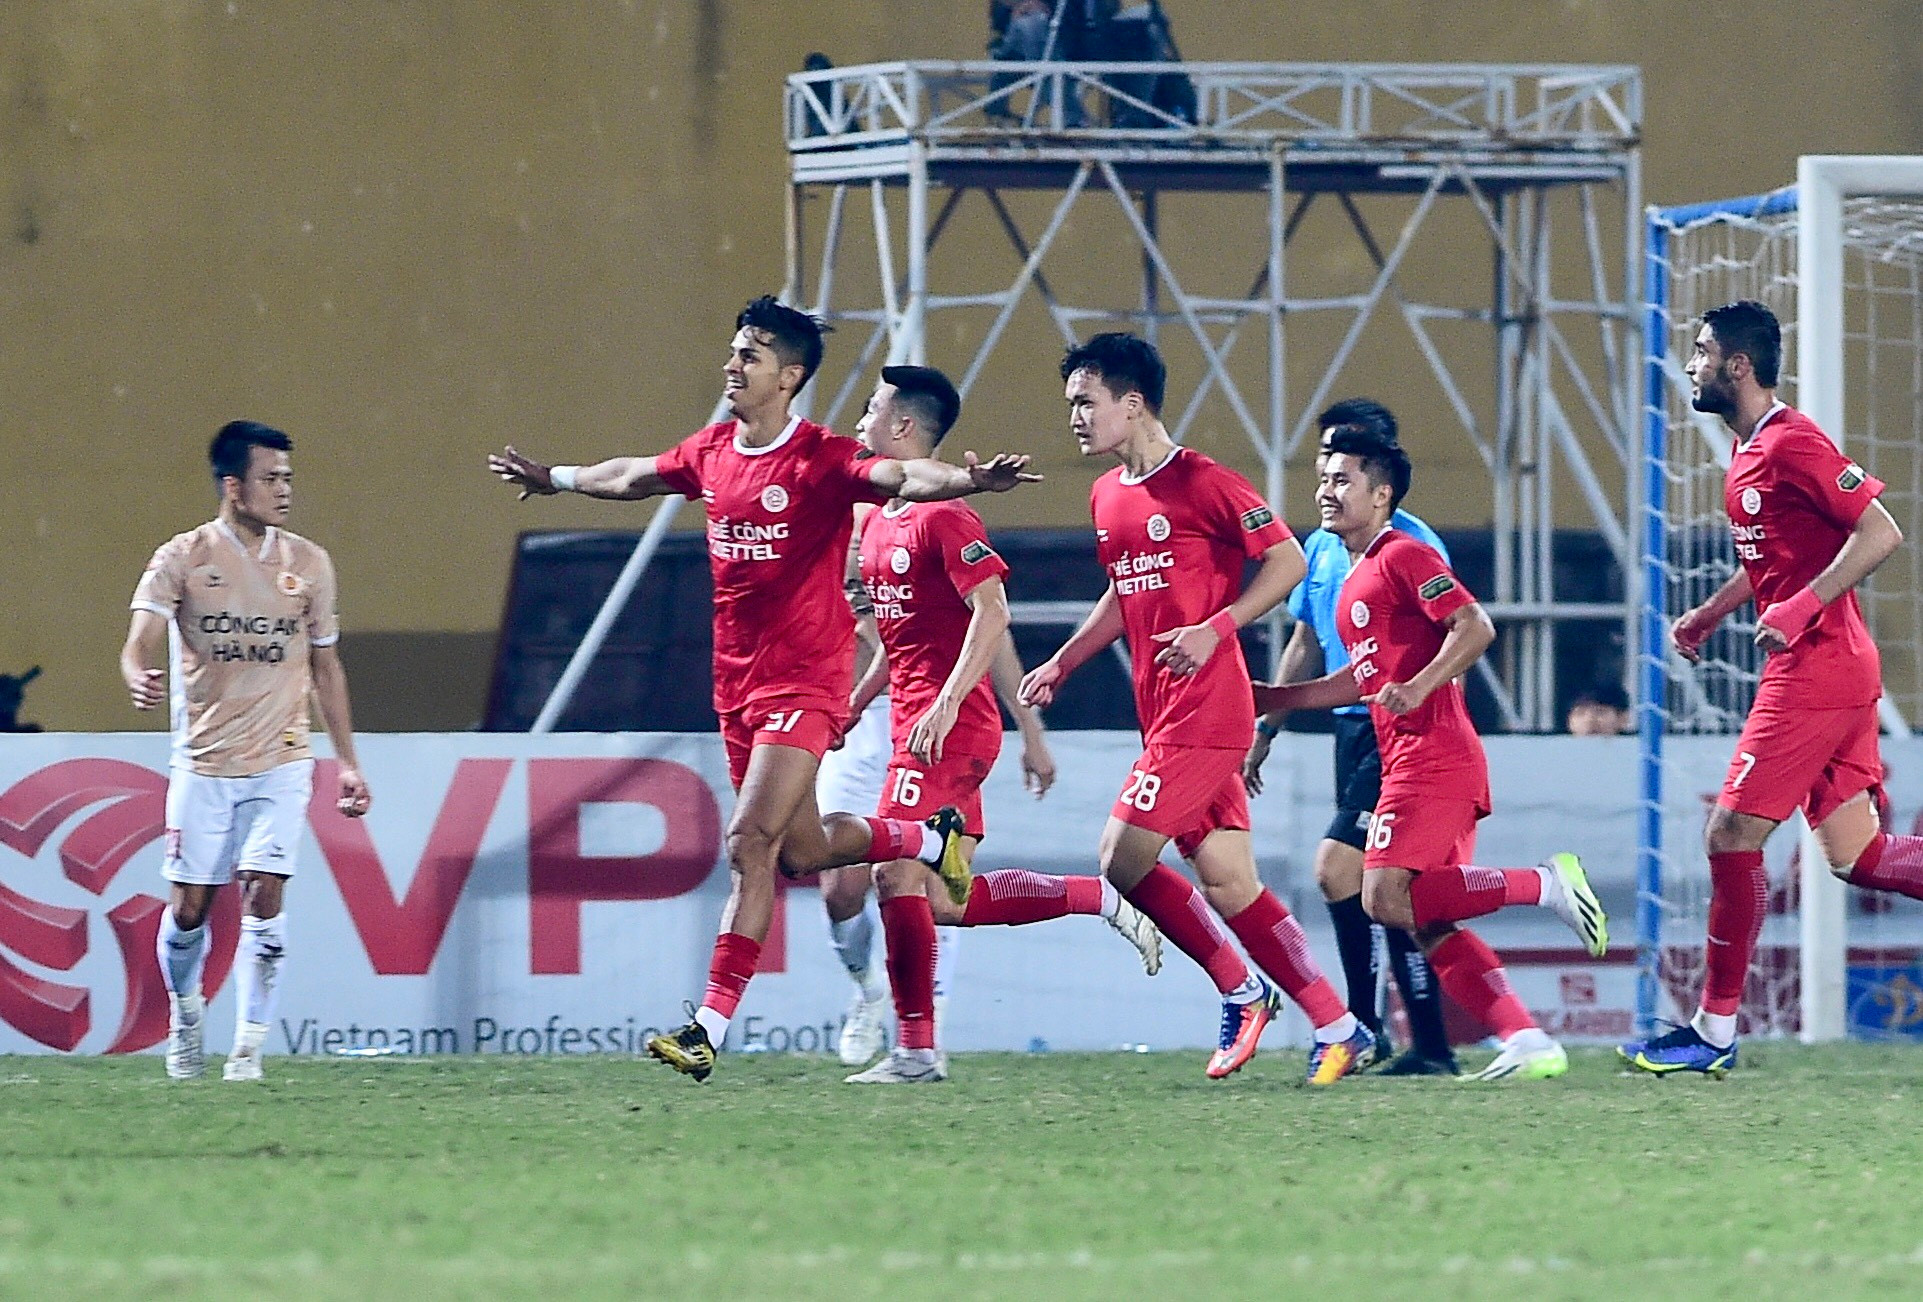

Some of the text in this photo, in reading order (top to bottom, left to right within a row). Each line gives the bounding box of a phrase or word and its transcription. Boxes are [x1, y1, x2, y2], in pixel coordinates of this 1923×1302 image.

[732, 521, 789, 541] CÔNG
[1132, 550, 1175, 573] CÔNG
[200, 610, 270, 635] CÔNG
[211, 639, 246, 663] HÀ
[1732, 751, 1757, 788] 7
[891, 767, 925, 808] 16
[1120, 769, 1162, 812] 28
[280, 1017, 457, 1055] Vietnam
